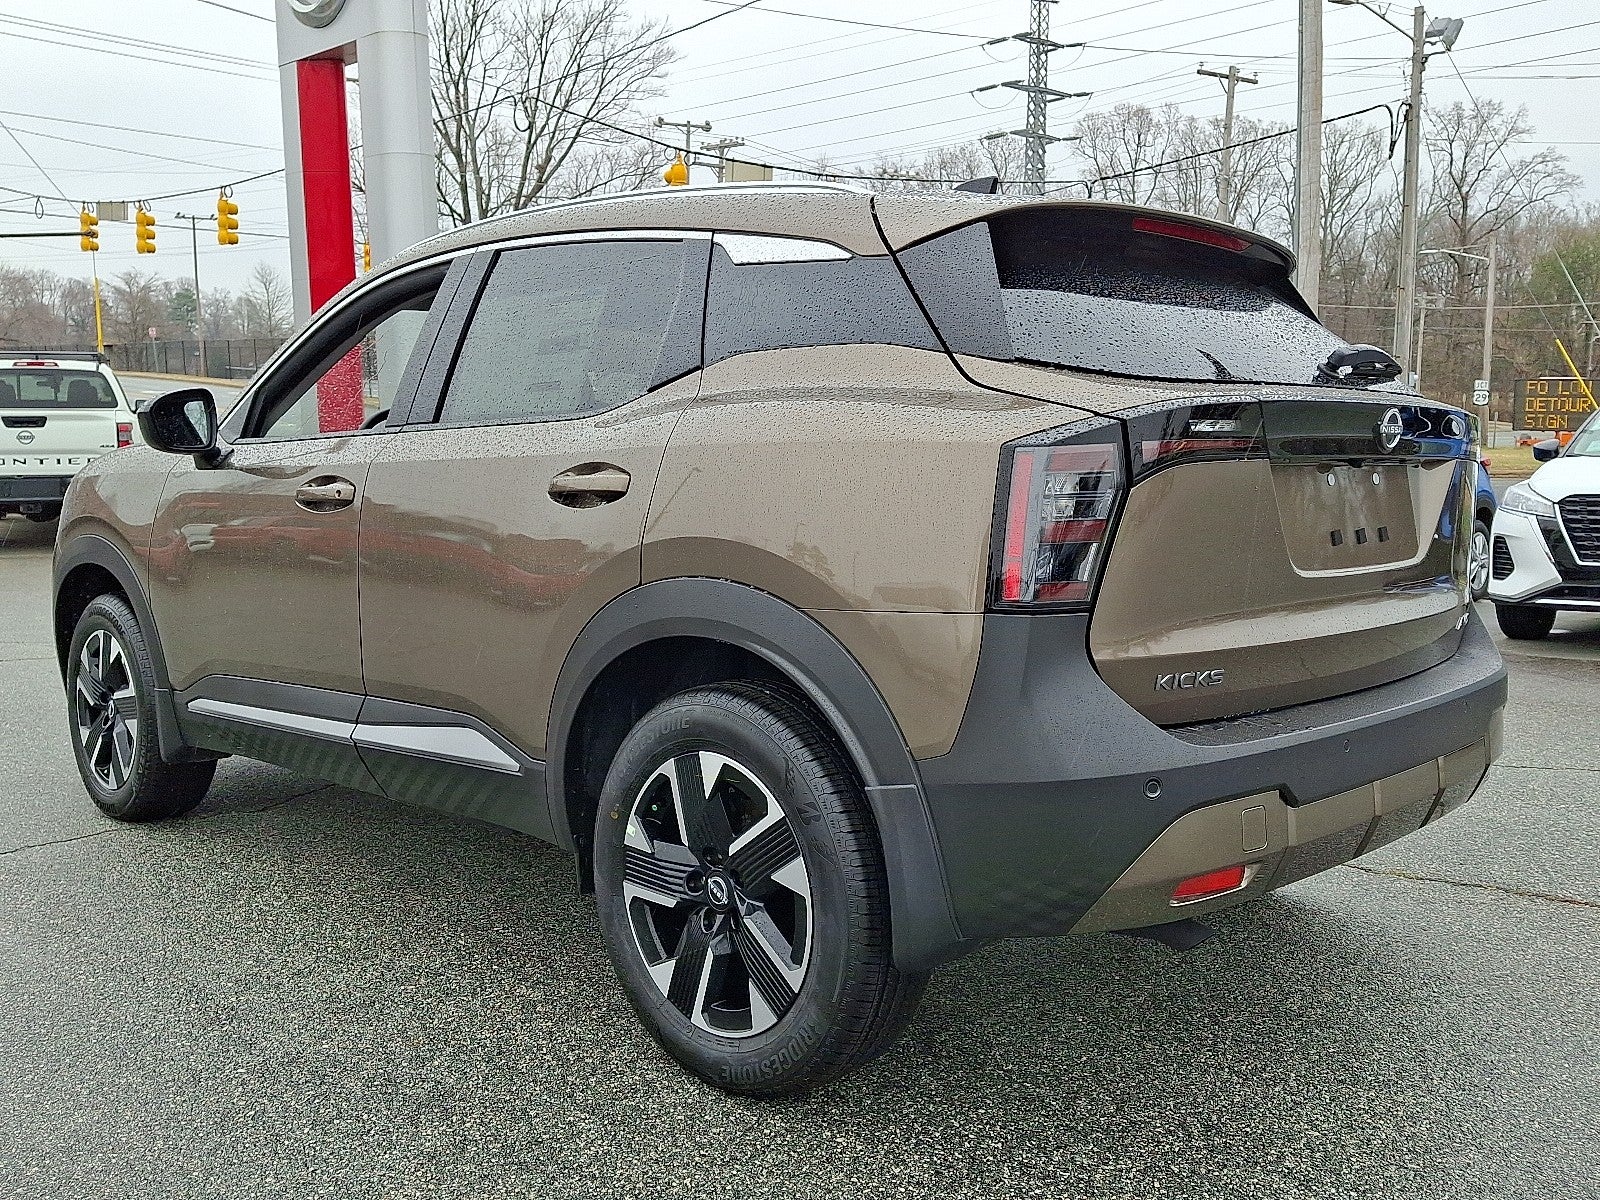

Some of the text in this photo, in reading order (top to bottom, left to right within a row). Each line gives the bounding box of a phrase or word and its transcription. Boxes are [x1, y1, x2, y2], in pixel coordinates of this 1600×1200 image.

[1474, 393, 1488, 402] 29
[1524, 397, 1592, 413] DETOUR
[1524, 414, 1568, 429] SIGN
[1154, 668, 1225, 691] KICKS
